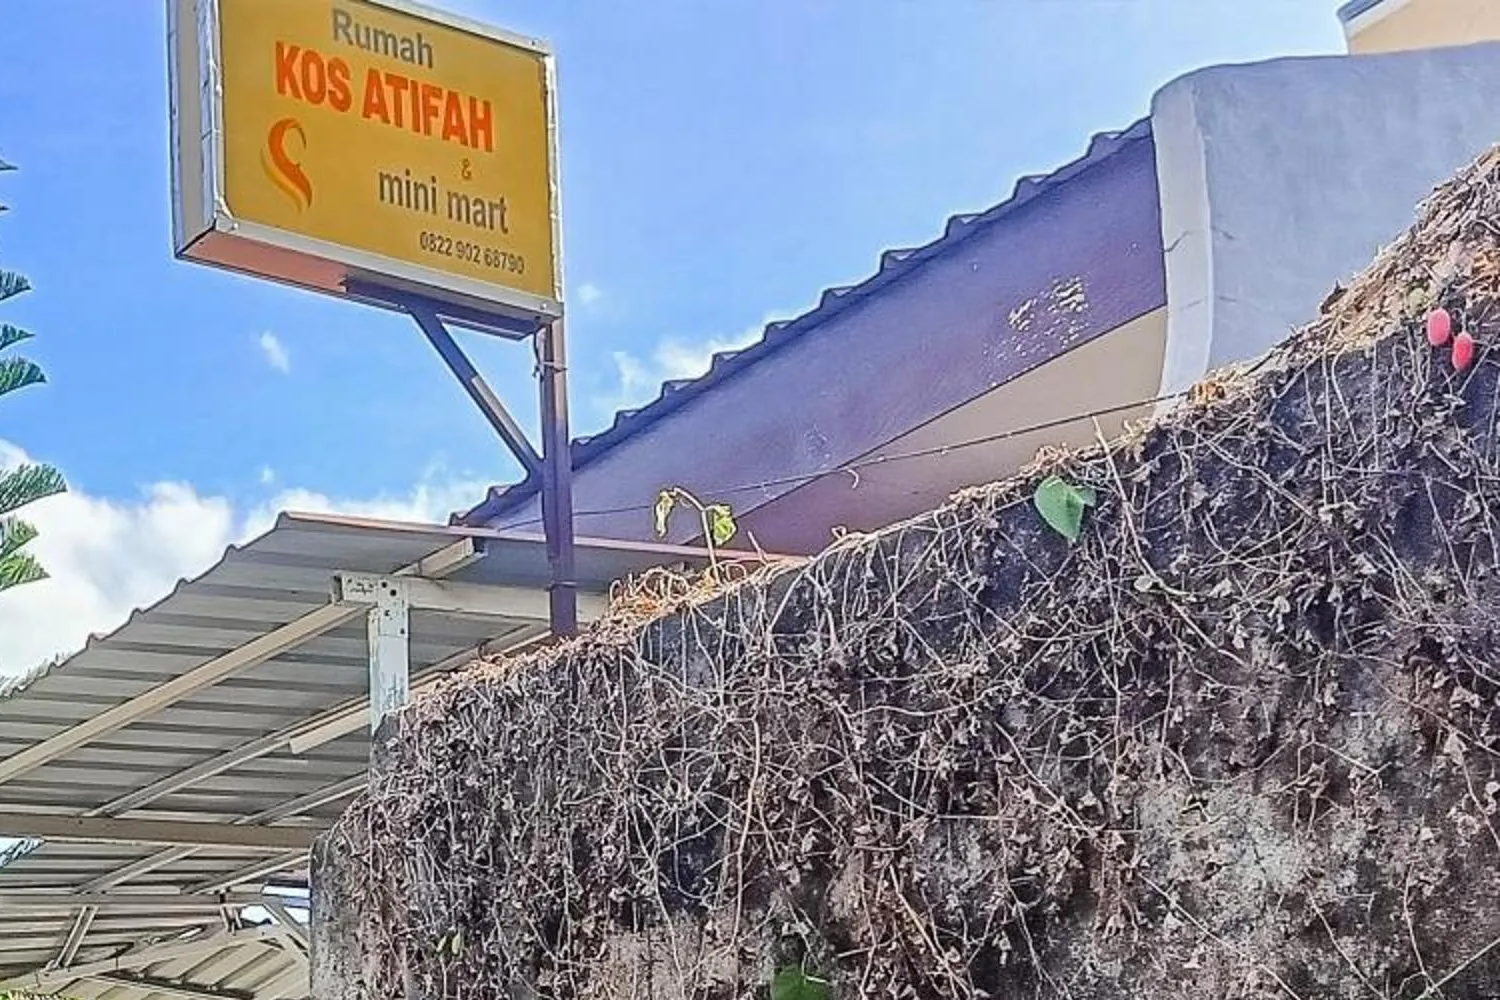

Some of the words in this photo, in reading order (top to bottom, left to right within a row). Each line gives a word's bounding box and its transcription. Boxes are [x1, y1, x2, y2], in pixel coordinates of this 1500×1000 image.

[332, 9, 433, 69] Rumah
[275, 41, 351, 112] KOS
[362, 68, 493, 153] ATIFAH
[460, 157, 473, 181] &
[378, 169, 437, 214] mini
[447, 189, 509, 234] mart
[419, 231, 453, 257] 0822
[455, 240, 482, 265] 902
